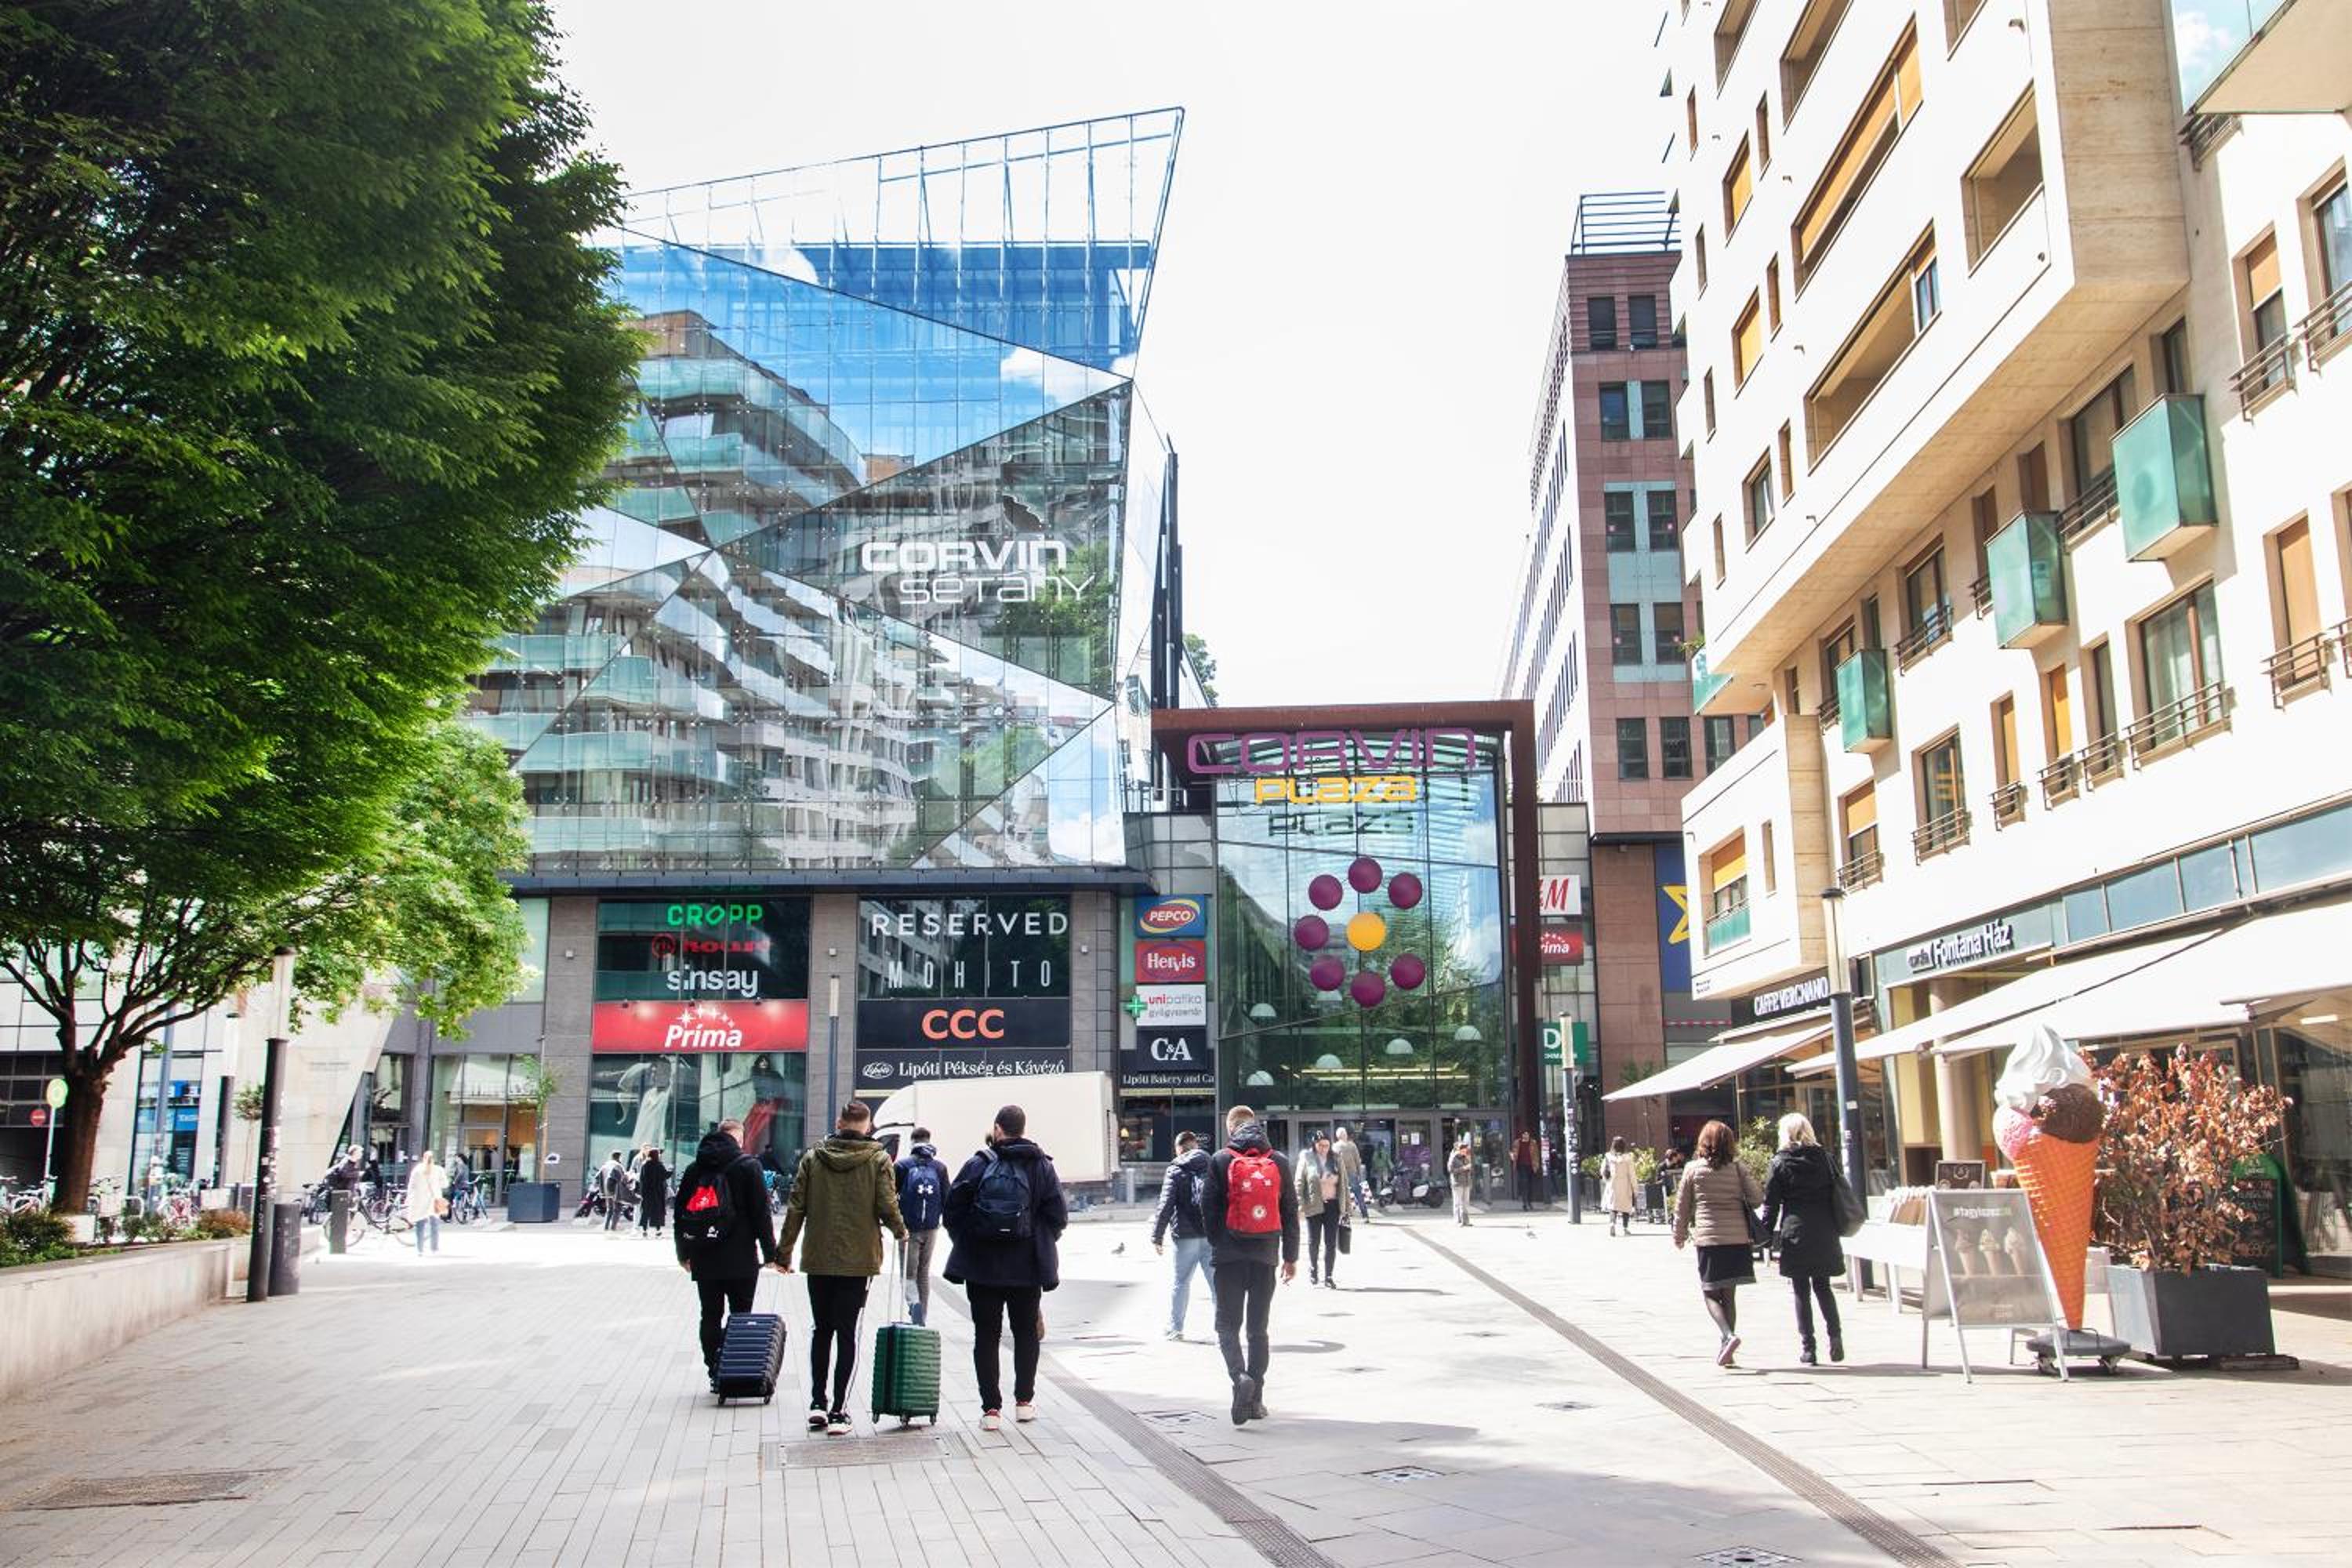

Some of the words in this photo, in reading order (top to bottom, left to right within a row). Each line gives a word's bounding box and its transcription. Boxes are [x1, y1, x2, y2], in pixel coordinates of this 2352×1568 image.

[667, 905, 764, 926] CROPP
[871, 913, 1069, 937] RESERVED
[1149, 910, 1192, 922] PEPCO
[1933, 933, 1984, 967] Fontana
[1983, 917, 2013, 954] Ház
[1147, 953, 1196, 971] Hervis
[666, 964, 759, 998] sinsay
[887, 960, 1051, 989] MOHITO
[921, 1009, 1004, 1040] CCC
[1150, 1037, 1192, 1062] C&A
[898, 1061, 940, 1079] Lipóti
[944, 1060, 994, 1079] Pékség
[996, 1059, 1013, 1076] és
[1014, 1058, 1065, 1076] Kávézó
[1150, 1073, 1182, 1086] Bakery
[1183, 1074, 1200, 1083] and
